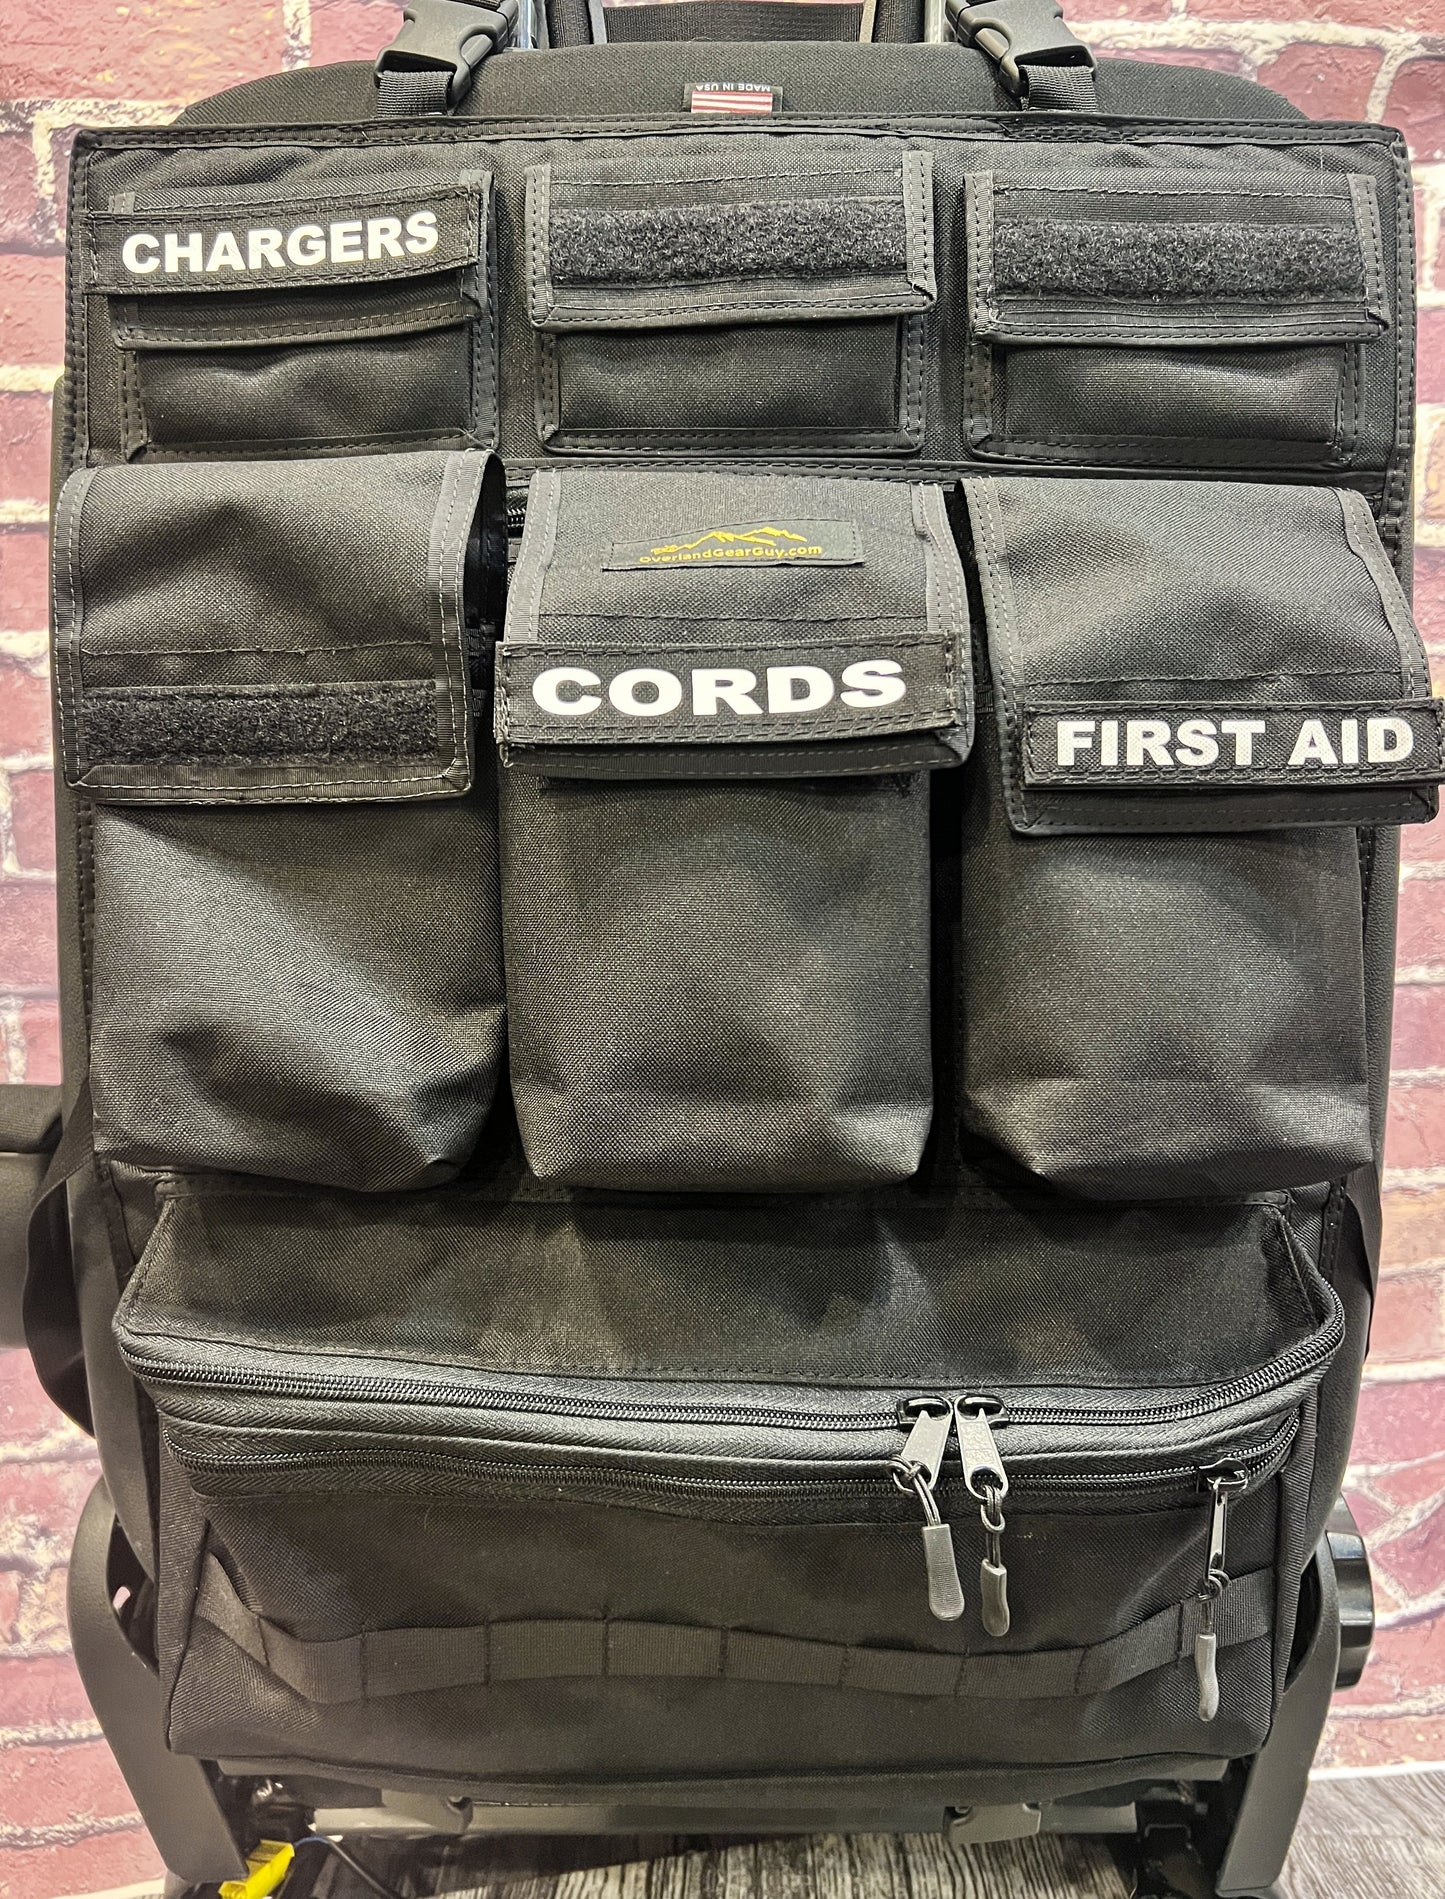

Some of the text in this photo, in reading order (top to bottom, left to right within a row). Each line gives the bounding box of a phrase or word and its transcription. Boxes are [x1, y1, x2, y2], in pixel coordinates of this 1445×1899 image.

[695, 83, 771, 92] MADE IN USA
[121, 209, 439, 275] CHARGERS
[639, 545, 823, 563] OverlandGearGuy.com
[531, 659, 907, 718] CORDS
[1056, 716, 1416, 767] FIRST AID
